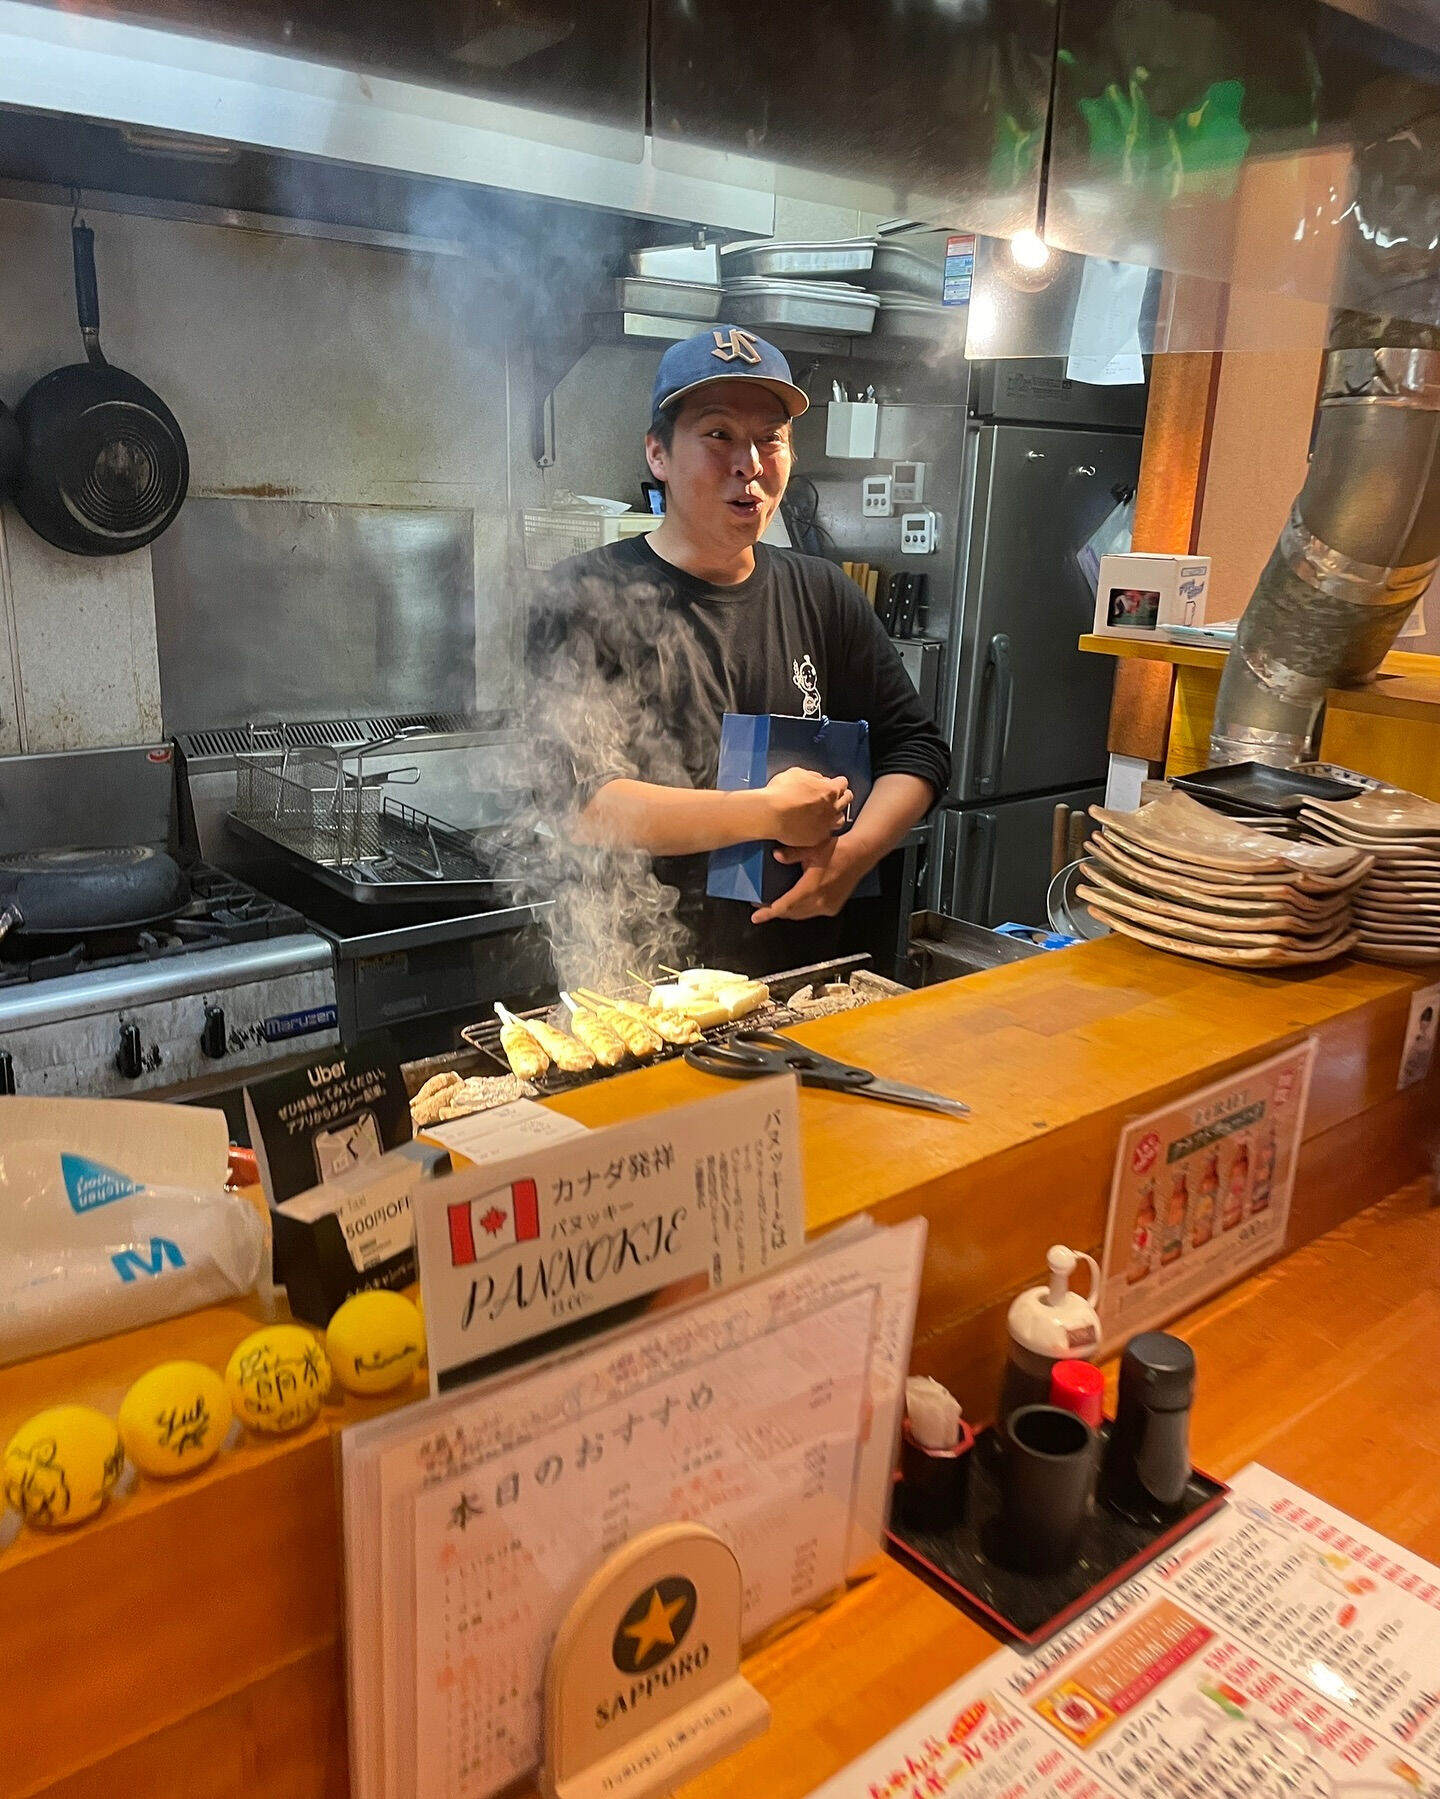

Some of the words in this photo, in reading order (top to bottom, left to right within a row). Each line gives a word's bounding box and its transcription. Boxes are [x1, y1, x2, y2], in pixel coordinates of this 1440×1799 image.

[307, 1060, 347, 1088] Uber
[551, 1142, 675, 1207] カナダ発祥
[549, 1202, 636, 1242] パヌッキー
[461, 1206, 688, 1331] PANNOKIE
[447, 1381, 714, 1532] 本日のおすすめ
[594, 1642, 711, 1731] SAPPORO
